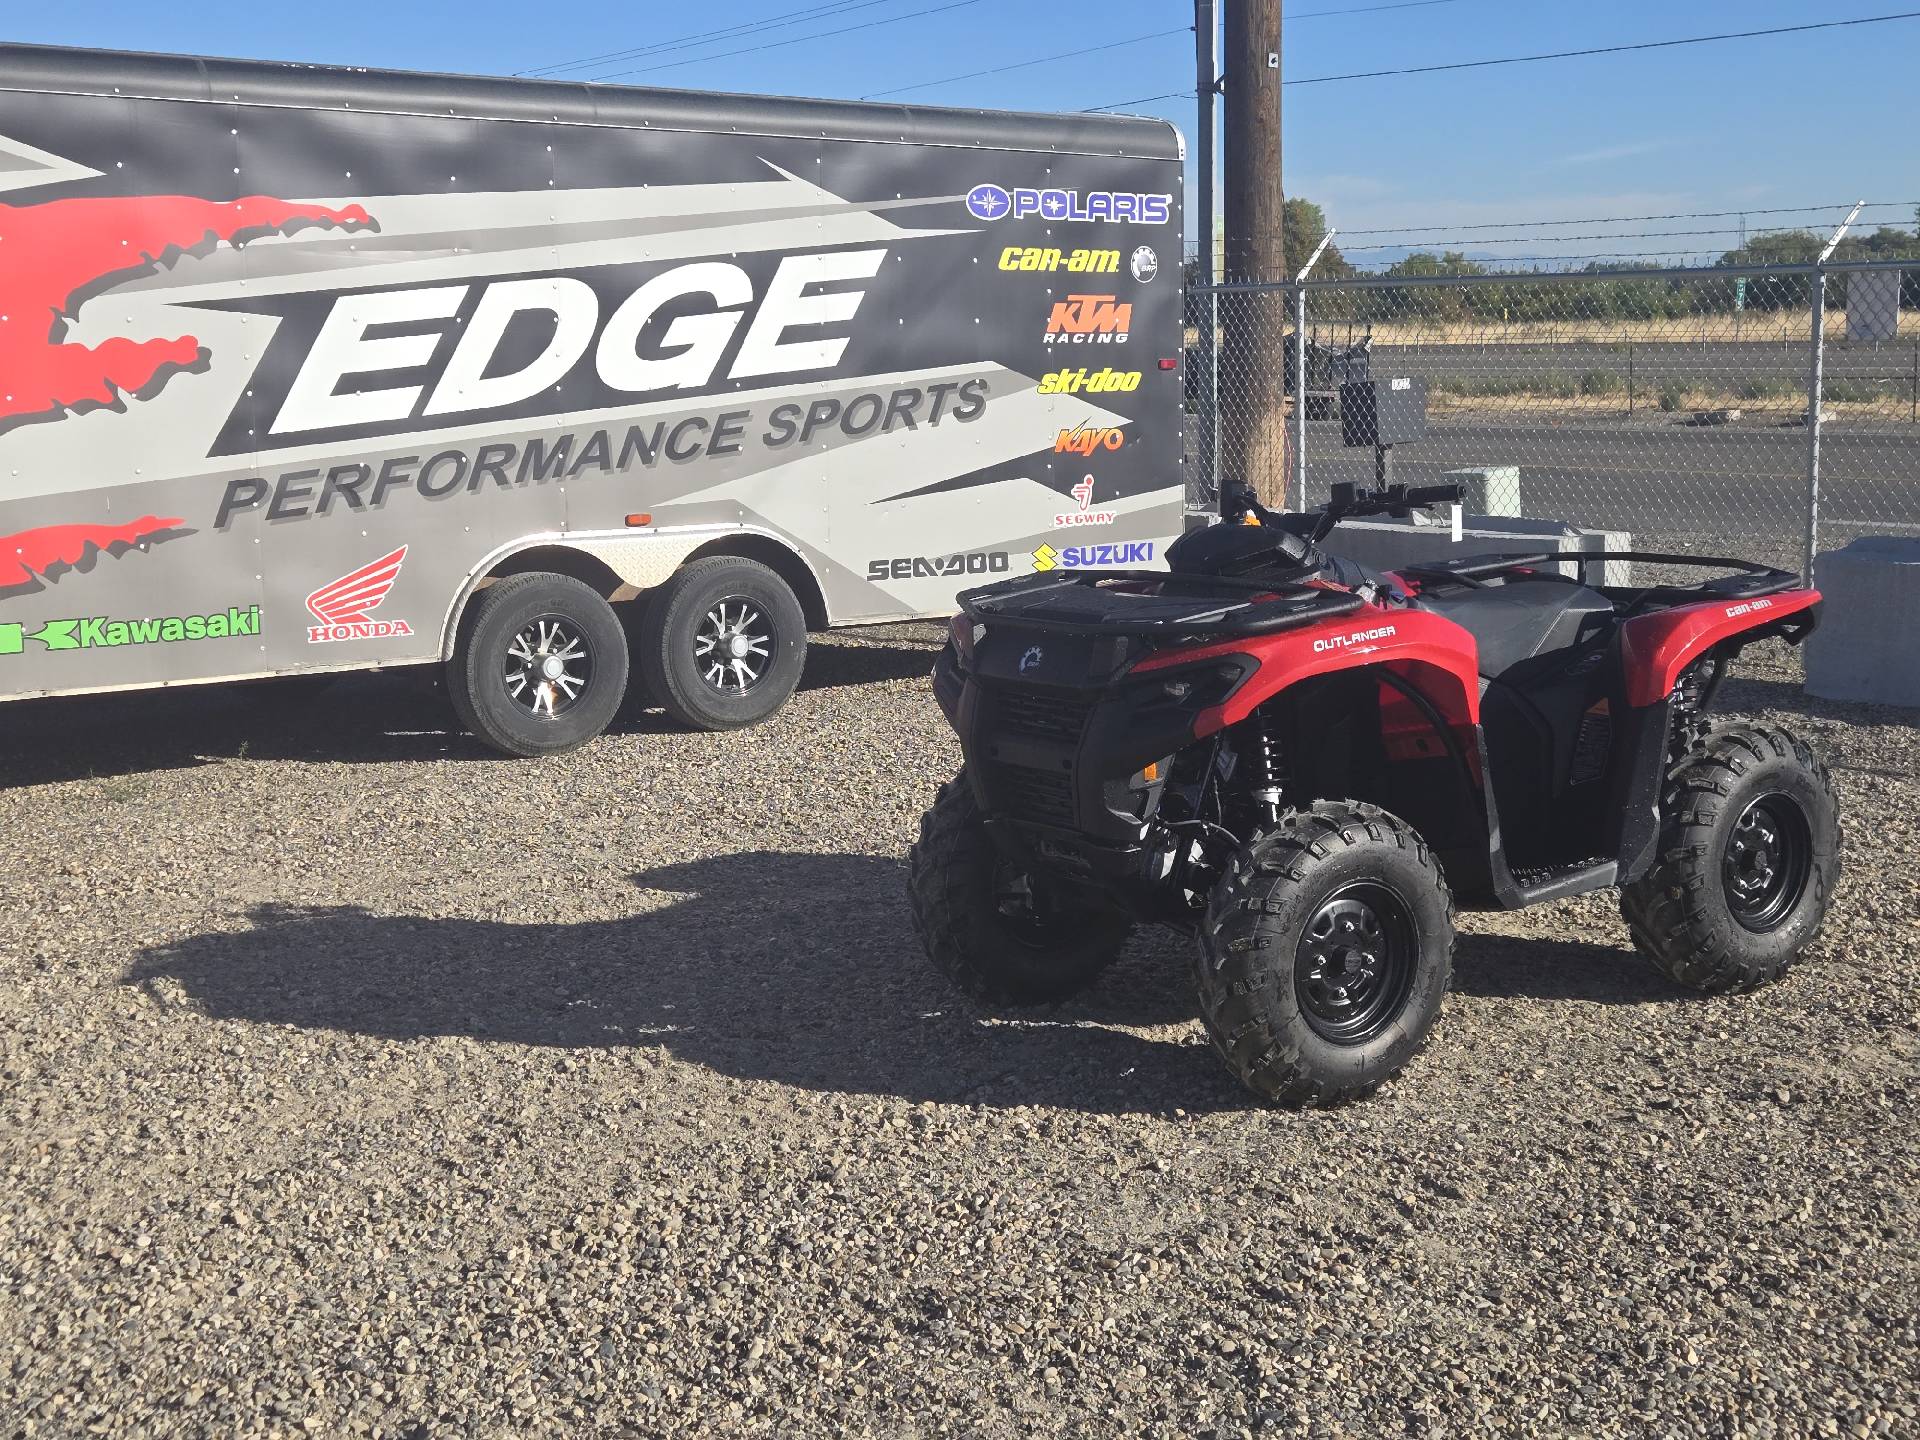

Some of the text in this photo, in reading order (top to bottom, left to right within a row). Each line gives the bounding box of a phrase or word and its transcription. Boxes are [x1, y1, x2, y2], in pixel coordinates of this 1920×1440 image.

[1014, 188, 1172, 224] POLARIS
[998, 247, 1120, 273] can-am
[1046, 295, 1132, 333] KTM
[268, 249, 888, 435] EDGE
[1043, 333, 1128, 344] RACING
[1038, 368, 1142, 394] ski-doo
[1055, 418, 1124, 456] KAYO
[213, 378, 989, 530] PERFORMANCE SPORTS
[1054, 512, 1116, 526] SEGWAY
[1063, 542, 1154, 568] SUZUKI
[1725, 599, 1773, 618] can-am
[79, 604, 261, 648] Kawasaki
[308, 620, 413, 643] HONDA
[1313, 625, 1397, 653] OUTLANDER
